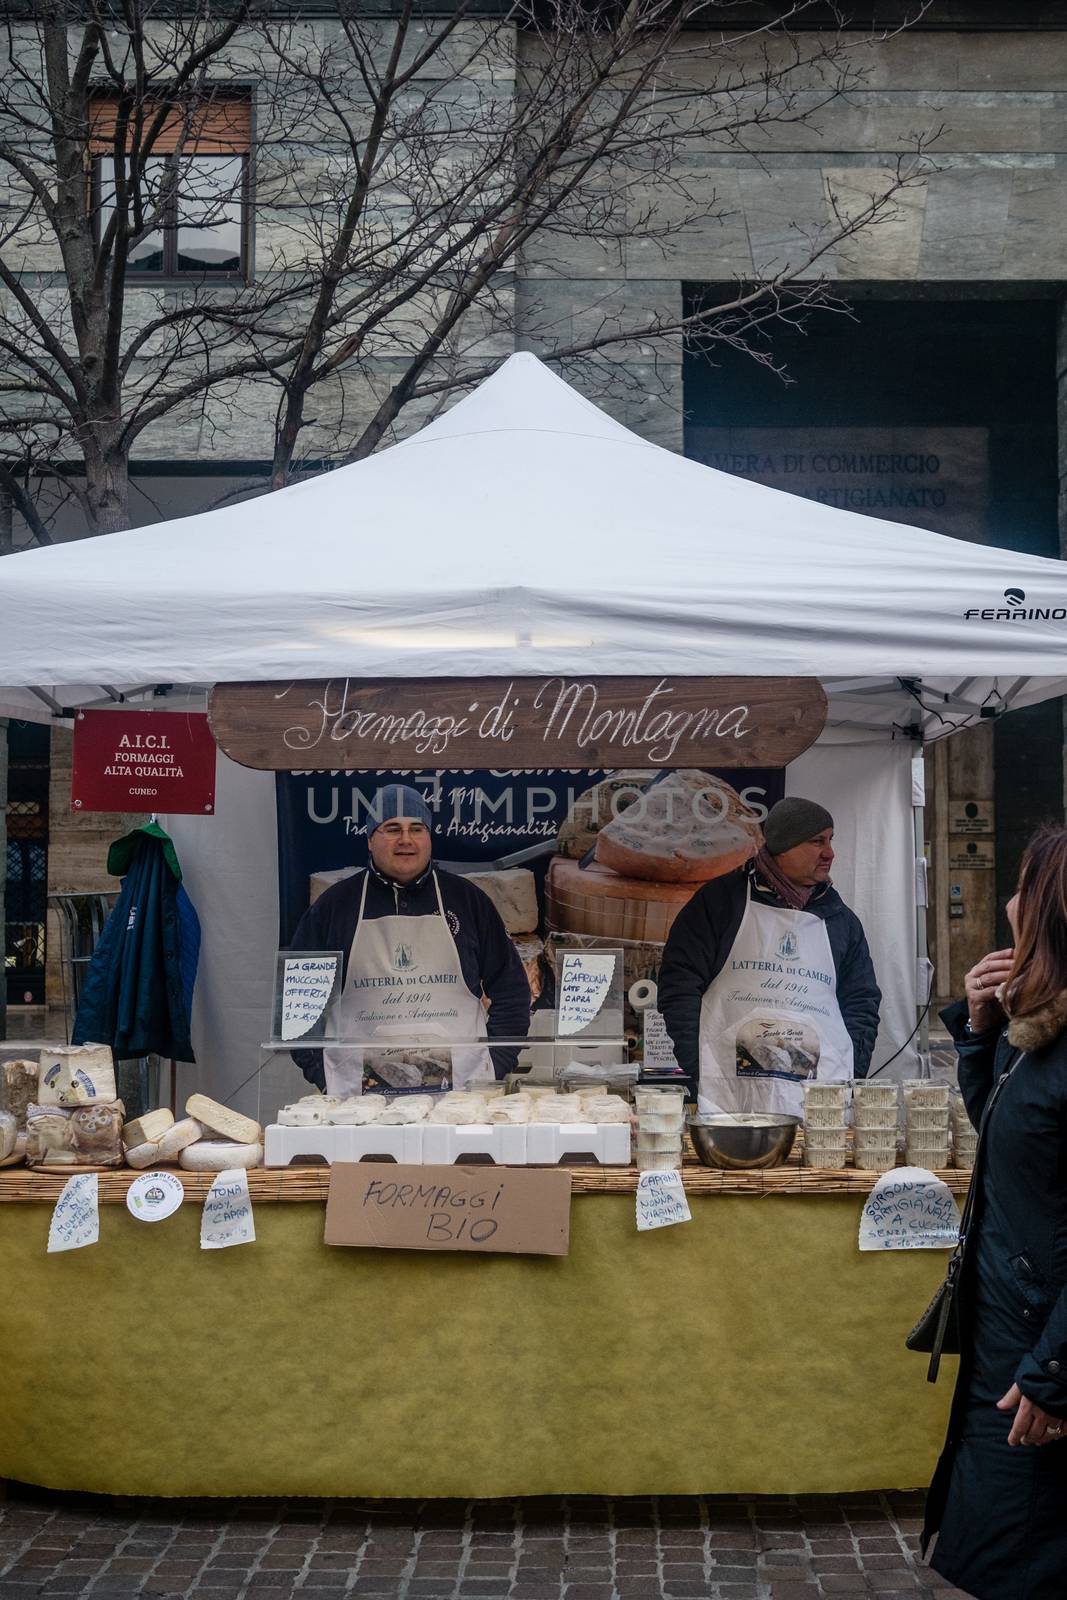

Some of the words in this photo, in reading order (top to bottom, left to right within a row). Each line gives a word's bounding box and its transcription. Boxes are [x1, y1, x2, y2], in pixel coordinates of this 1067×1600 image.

[783, 454, 806, 473] DI
[812, 454, 941, 474] COMMERCIO
[963, 608, 1067, 620] FERRINO
[478, 681, 520, 742] di
[534, 677, 752, 762] Montagna
[118, 734, 171, 749] A.I.C.I.
[114, 752, 175, 764] FORMAGGI
[103, 765, 133, 776] ALTA
[134, 765, 184, 778] QUALITÀ
[128, 787, 158, 796] CUNEO
[434, 823, 443, 834] e
[446, 816, 558, 843] Artigianalità
[286, 962, 300, 971] LA
[565, 958, 582, 968] LA
[285, 975, 330, 985] MUCCONA
[732, 960, 783, 973] LATTERIA
[798, 968, 832, 986] CAMERI
[353, 976, 403, 989] LATTERIA
[418, 974, 459, 985] CAMERI
[760, 977, 781, 990] dal
[784, 982, 809, 995] 1914
[284, 988, 328, 998] OFFERTA
[382, 991, 402, 1005] dal
[405, 991, 432, 1004] 1914
[564, 995, 591, 1003] CAPRA
[211, 1184, 242, 1198] TOMA
[650, 1188, 664, 1197] DI
[640, 1194, 674, 1209] NONNA
[865, 1181, 953, 1217] GORGONZOLA
[212, 1206, 249, 1224] CAPRA
[873, 1198, 956, 1226] ARTIGIANALE
[891, 1213, 904, 1225] A
